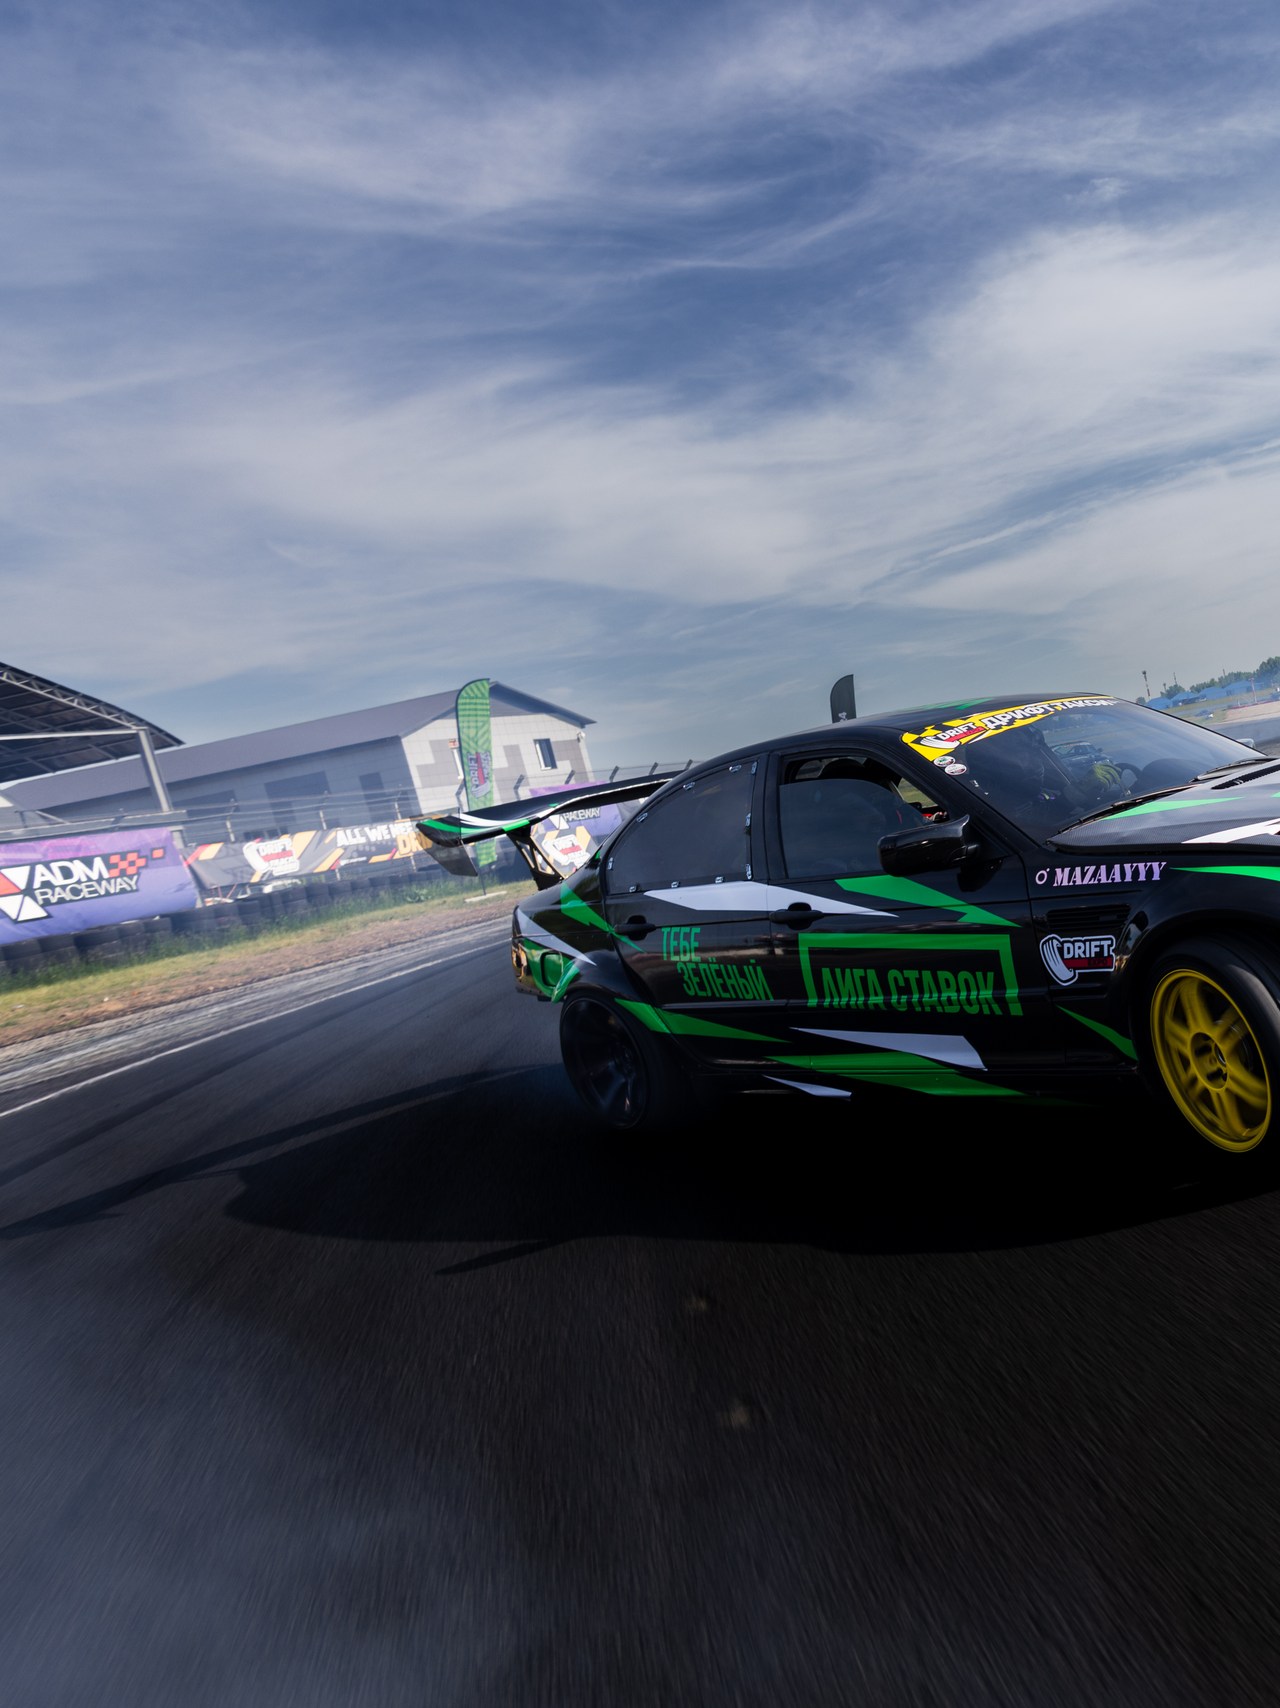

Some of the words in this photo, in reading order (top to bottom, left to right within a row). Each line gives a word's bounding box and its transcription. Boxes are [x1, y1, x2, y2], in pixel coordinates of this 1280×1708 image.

[981, 703, 1056, 729] ДРИФТ
[936, 722, 978, 740] DRIFT
[337, 827, 366, 847] ALL
[364, 824, 391, 842] WE
[32, 856, 110, 889] ADM
[1053, 862, 1167, 887] MAZAAYYY
[34, 875, 138, 905] RACEWAY
[661, 927, 702, 962] ТЕБЕ
[1063, 940, 1112, 959] DRIFT
[677, 957, 774, 1001] ЗЕЛЁНЫЙ
[821, 967, 887, 1011] ЛИГА
[887, 968, 1003, 1016] СТАВОК
